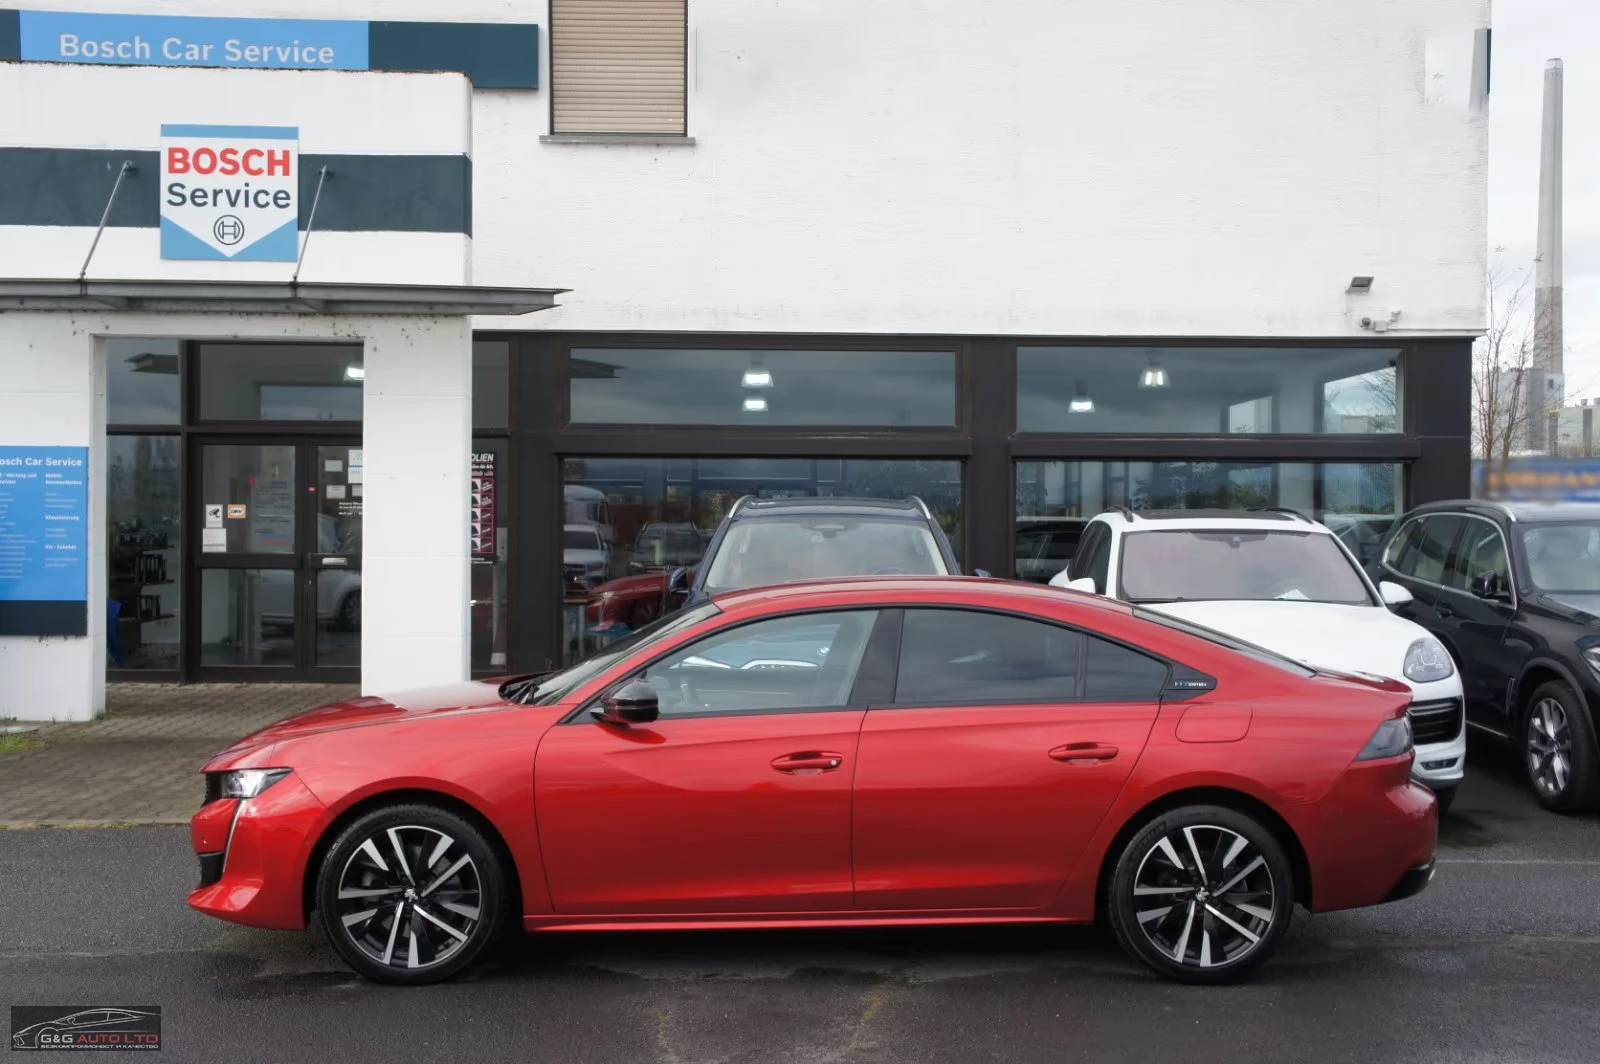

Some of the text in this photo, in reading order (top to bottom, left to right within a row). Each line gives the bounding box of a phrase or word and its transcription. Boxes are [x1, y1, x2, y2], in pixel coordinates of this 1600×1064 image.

[59, 33, 335, 64] Bosch Car Service
[168, 147, 290, 177] BOSCH
[167, 182, 291, 209] Service
[0, 457, 83, 466] osch Car Service
[472, 453, 494, 462] OLIEN
